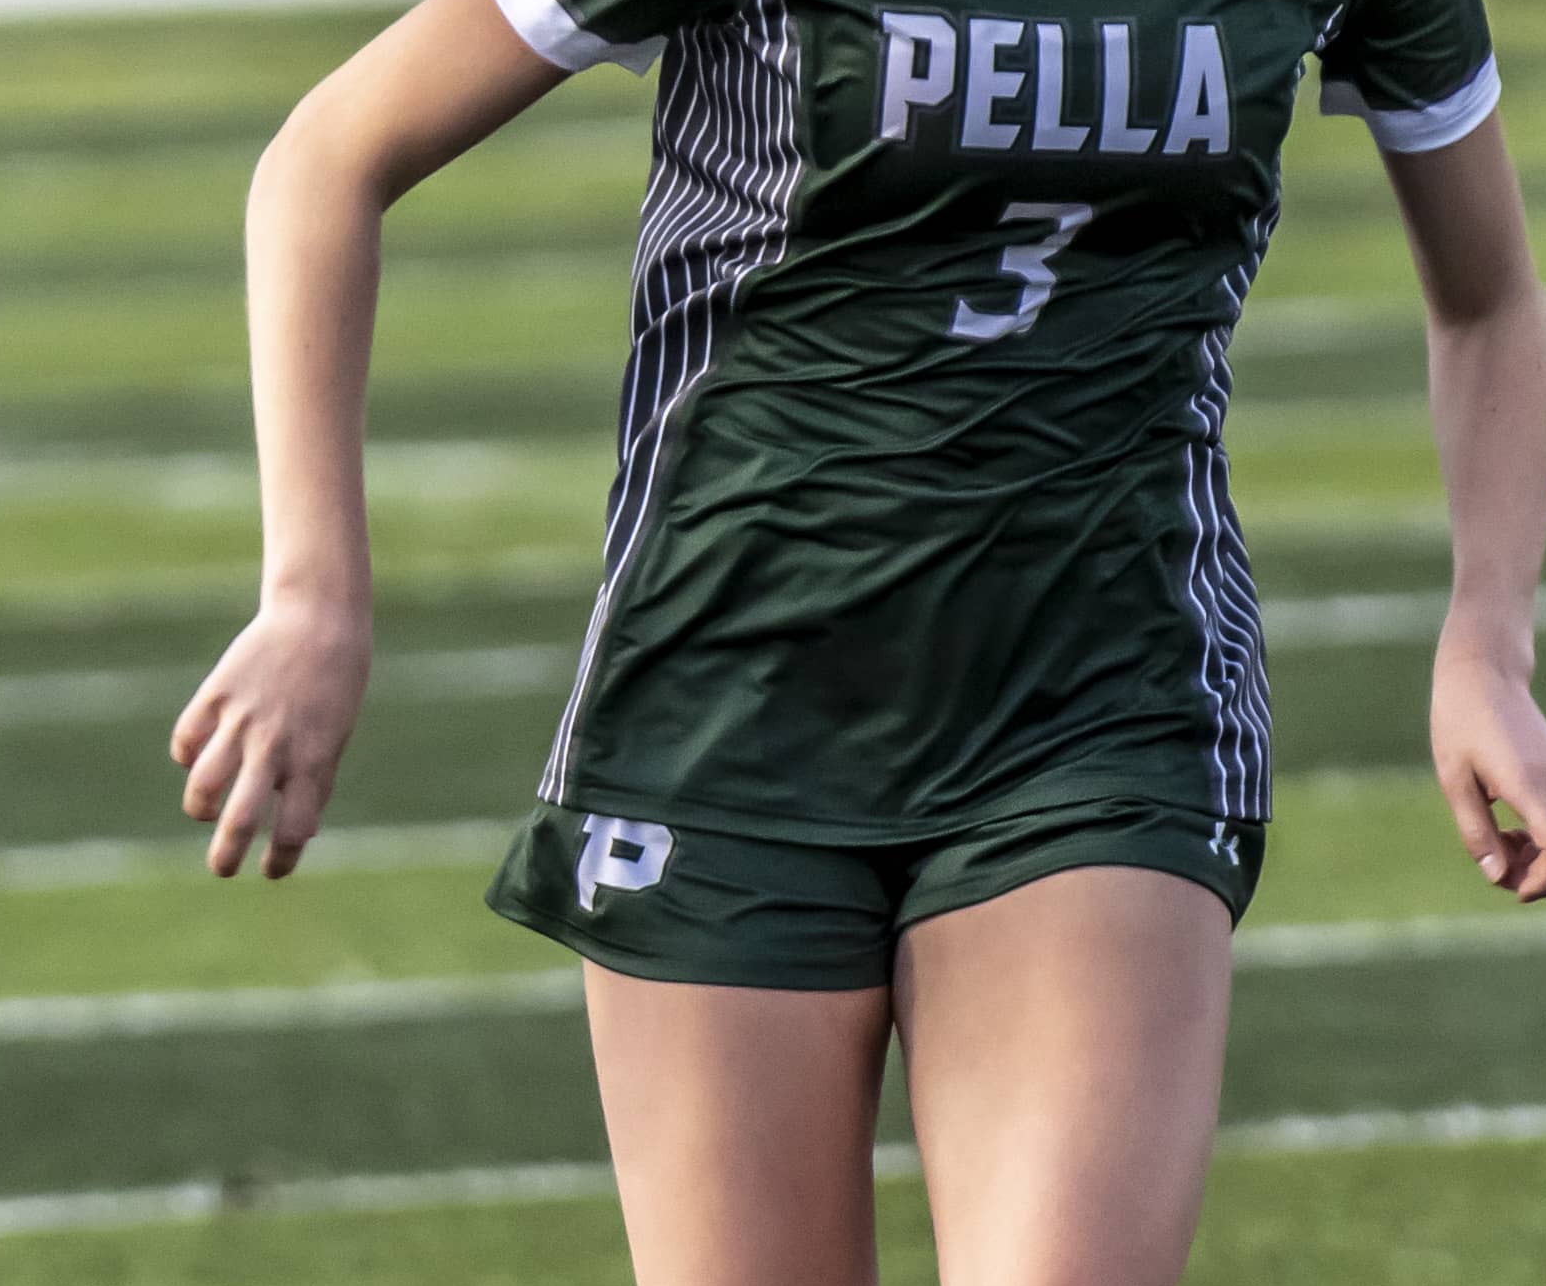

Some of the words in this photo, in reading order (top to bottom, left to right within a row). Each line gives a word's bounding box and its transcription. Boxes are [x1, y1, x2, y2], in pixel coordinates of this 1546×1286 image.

[879, 10, 1232, 155] PELLA
[948, 201, 1094, 340] 3
[576, 812, 675, 913] P
